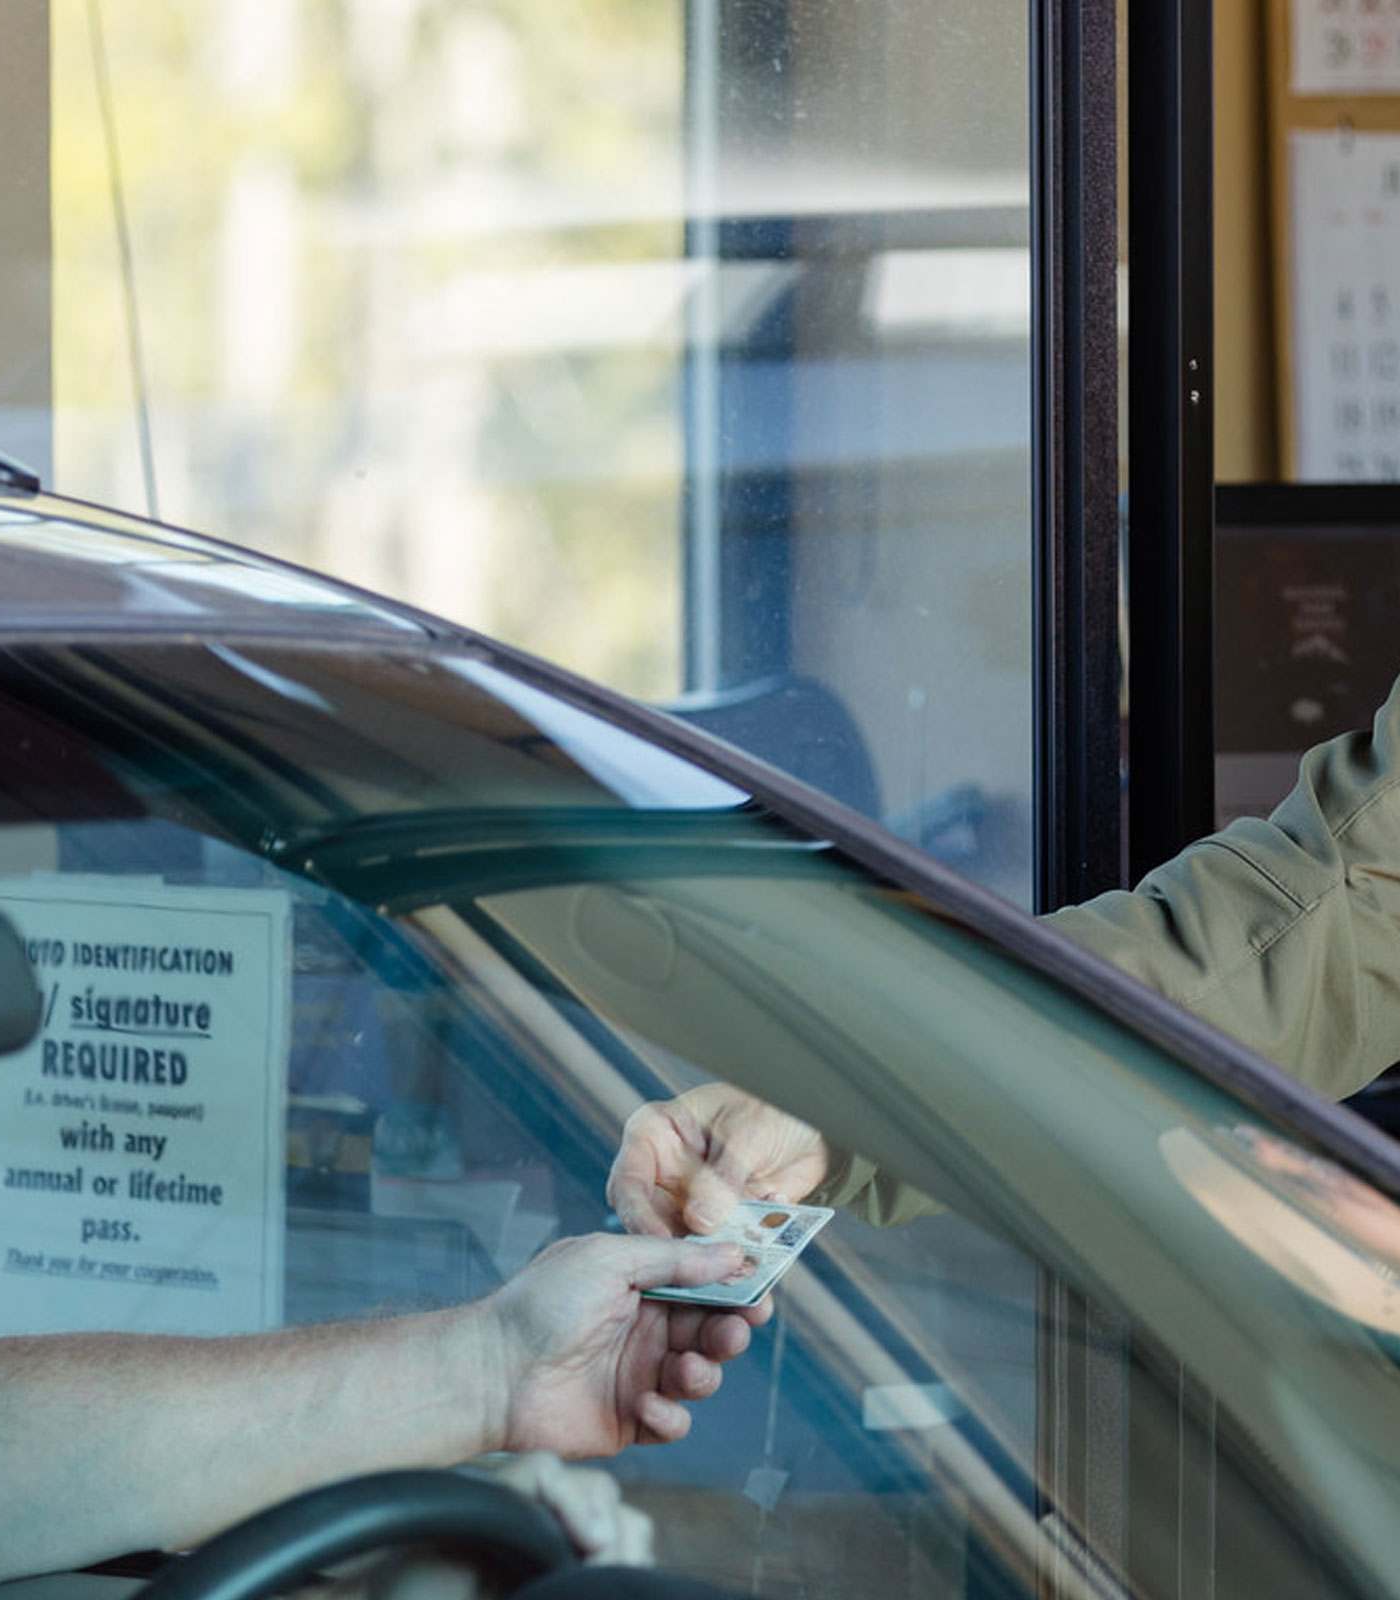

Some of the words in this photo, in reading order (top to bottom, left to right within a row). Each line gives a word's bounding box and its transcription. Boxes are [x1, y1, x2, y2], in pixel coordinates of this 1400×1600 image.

[73, 942, 233, 977] IDENTIFICATION
[71, 986, 211, 1031] signature
[42, 1039, 188, 1087] REQUIRED
[60, 1120, 114, 1152] with
[124, 1132, 167, 1161] any
[4, 1166, 83, 1194] annual
[92, 1175, 118, 1196] or
[129, 1169, 224, 1206] lifetime
[82, 1218, 141, 1243] pass.
